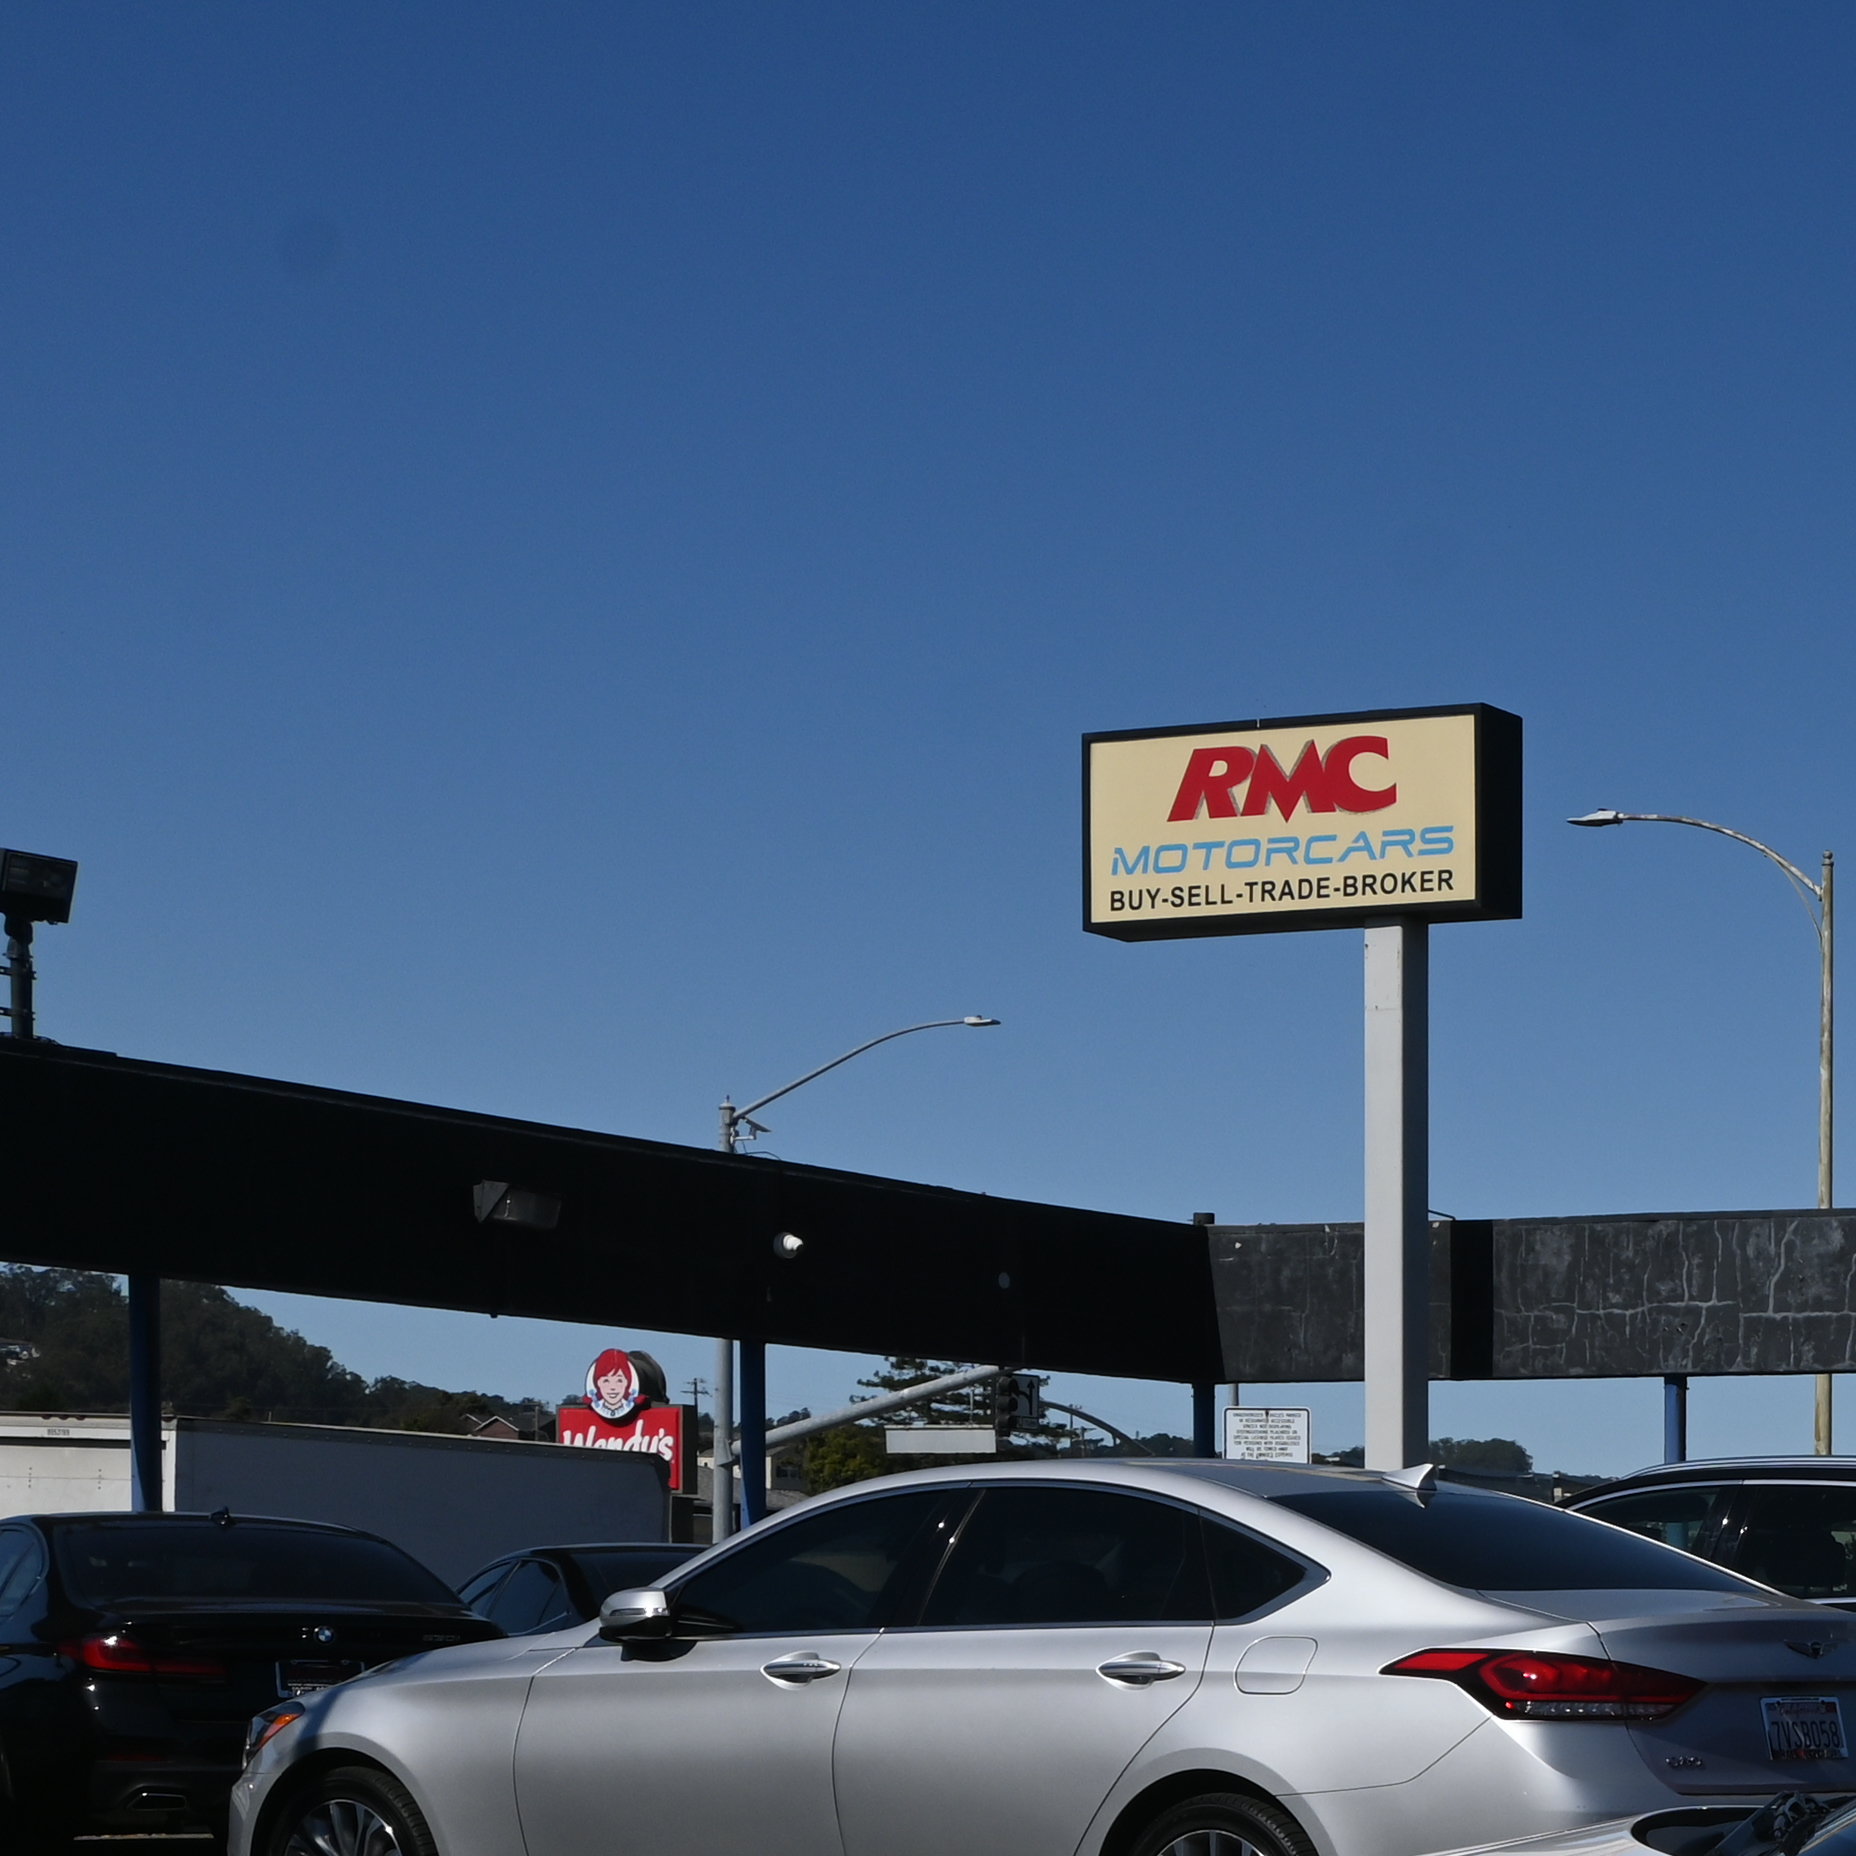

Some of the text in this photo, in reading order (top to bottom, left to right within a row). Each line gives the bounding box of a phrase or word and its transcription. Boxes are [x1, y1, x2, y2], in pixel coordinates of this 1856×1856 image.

[1167, 735, 1397, 823] RMC
[1111, 825, 1454, 876] MOTORCARS
[1110, 869, 1454, 911] BUY-SELL-TRADE-BROKER
[1771, 1720, 1841, 1751] 7VSB058
